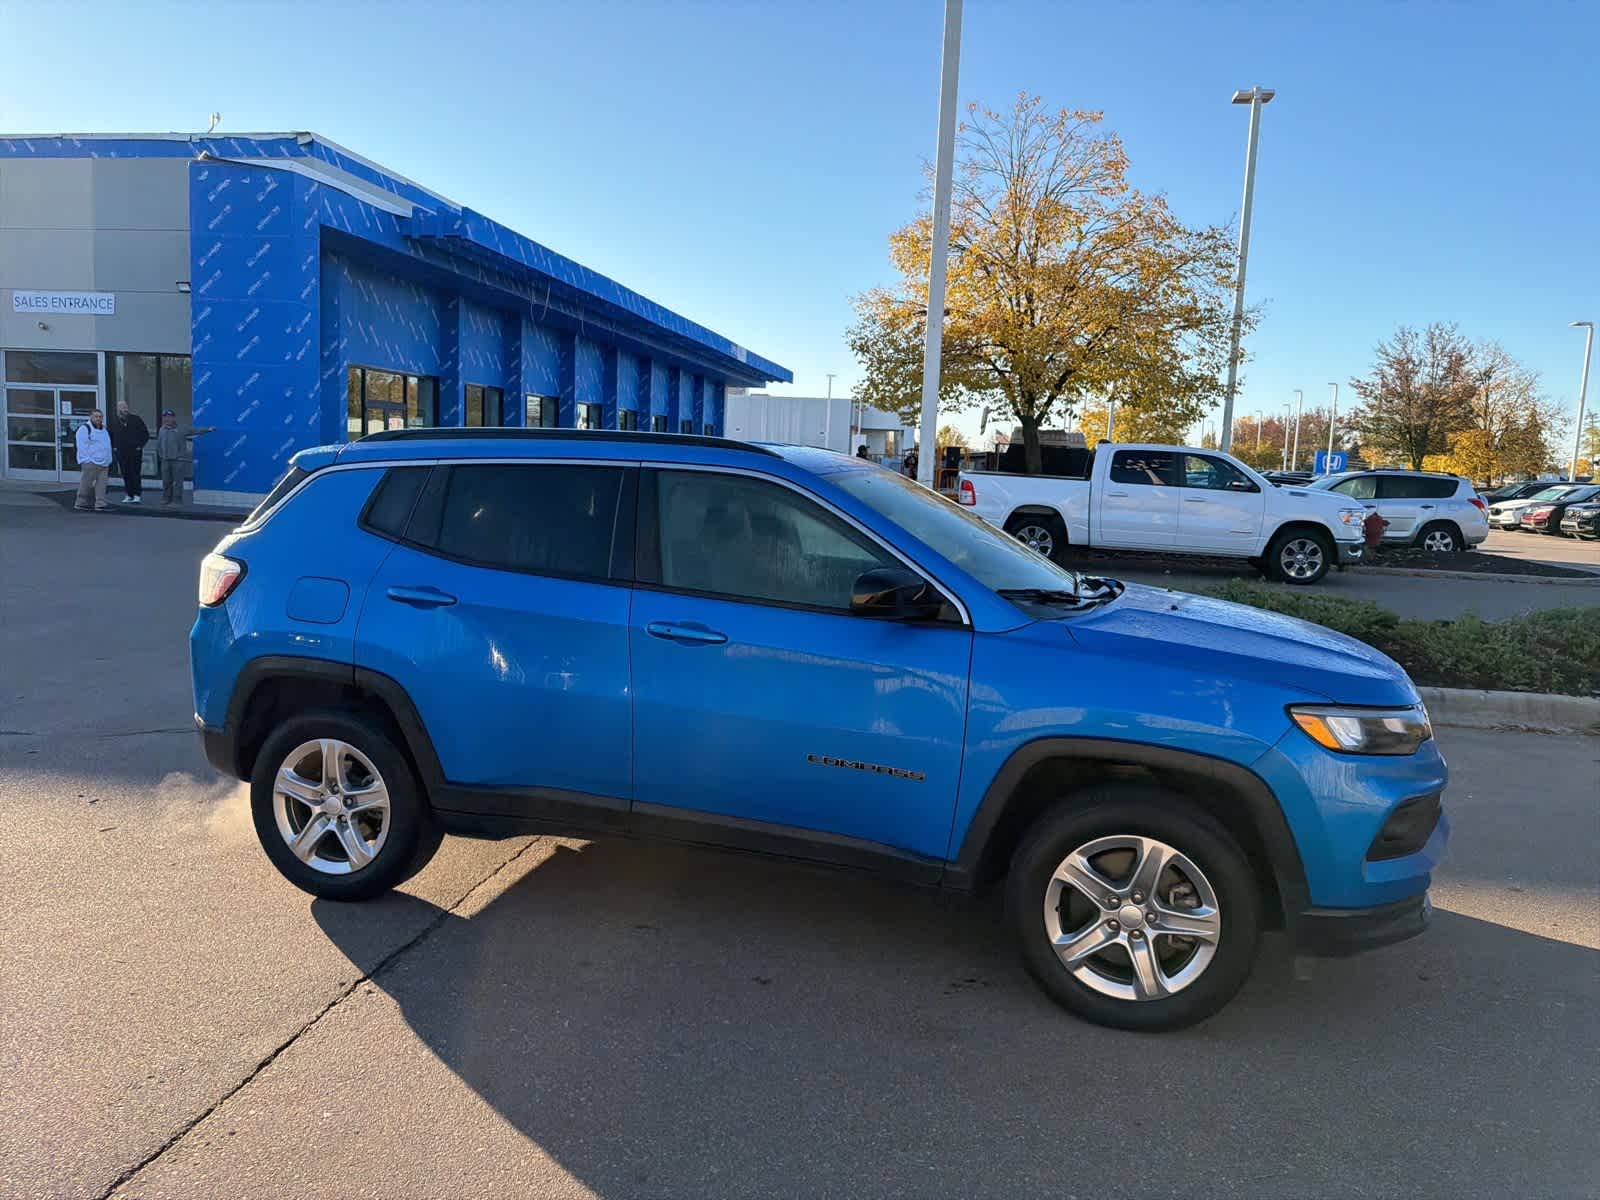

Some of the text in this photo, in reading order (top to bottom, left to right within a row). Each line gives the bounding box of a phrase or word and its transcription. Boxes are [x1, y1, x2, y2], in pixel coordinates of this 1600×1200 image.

[14, 296, 113, 310] SALES ENTRANCE
[807, 754, 926, 781] COMPASS
